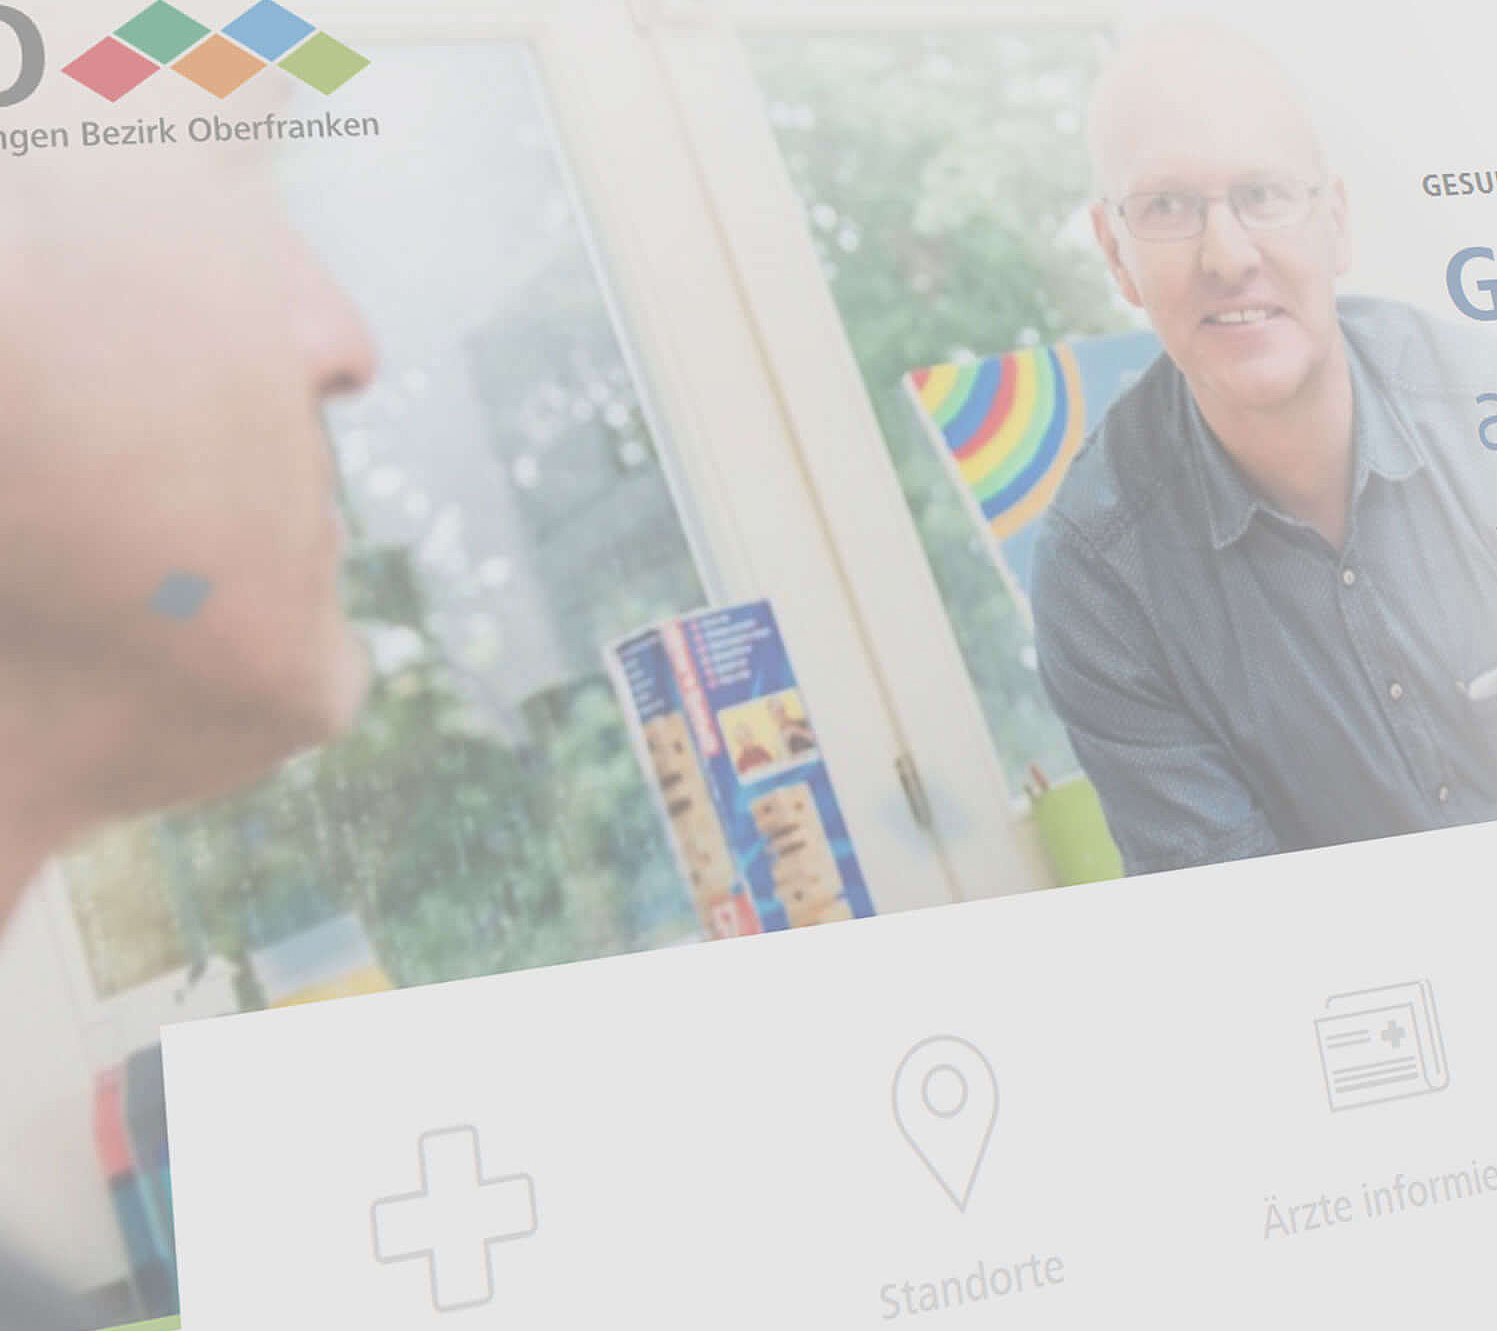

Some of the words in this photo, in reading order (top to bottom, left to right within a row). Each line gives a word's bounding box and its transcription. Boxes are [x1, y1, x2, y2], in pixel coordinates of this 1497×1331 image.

[81, 117, 177, 147] Bezirk
[187, 111, 379, 143] Oberfranken
[1263, 1194, 1353, 1241] Ärzte
[879, 1253, 1065, 1321] Standorte
